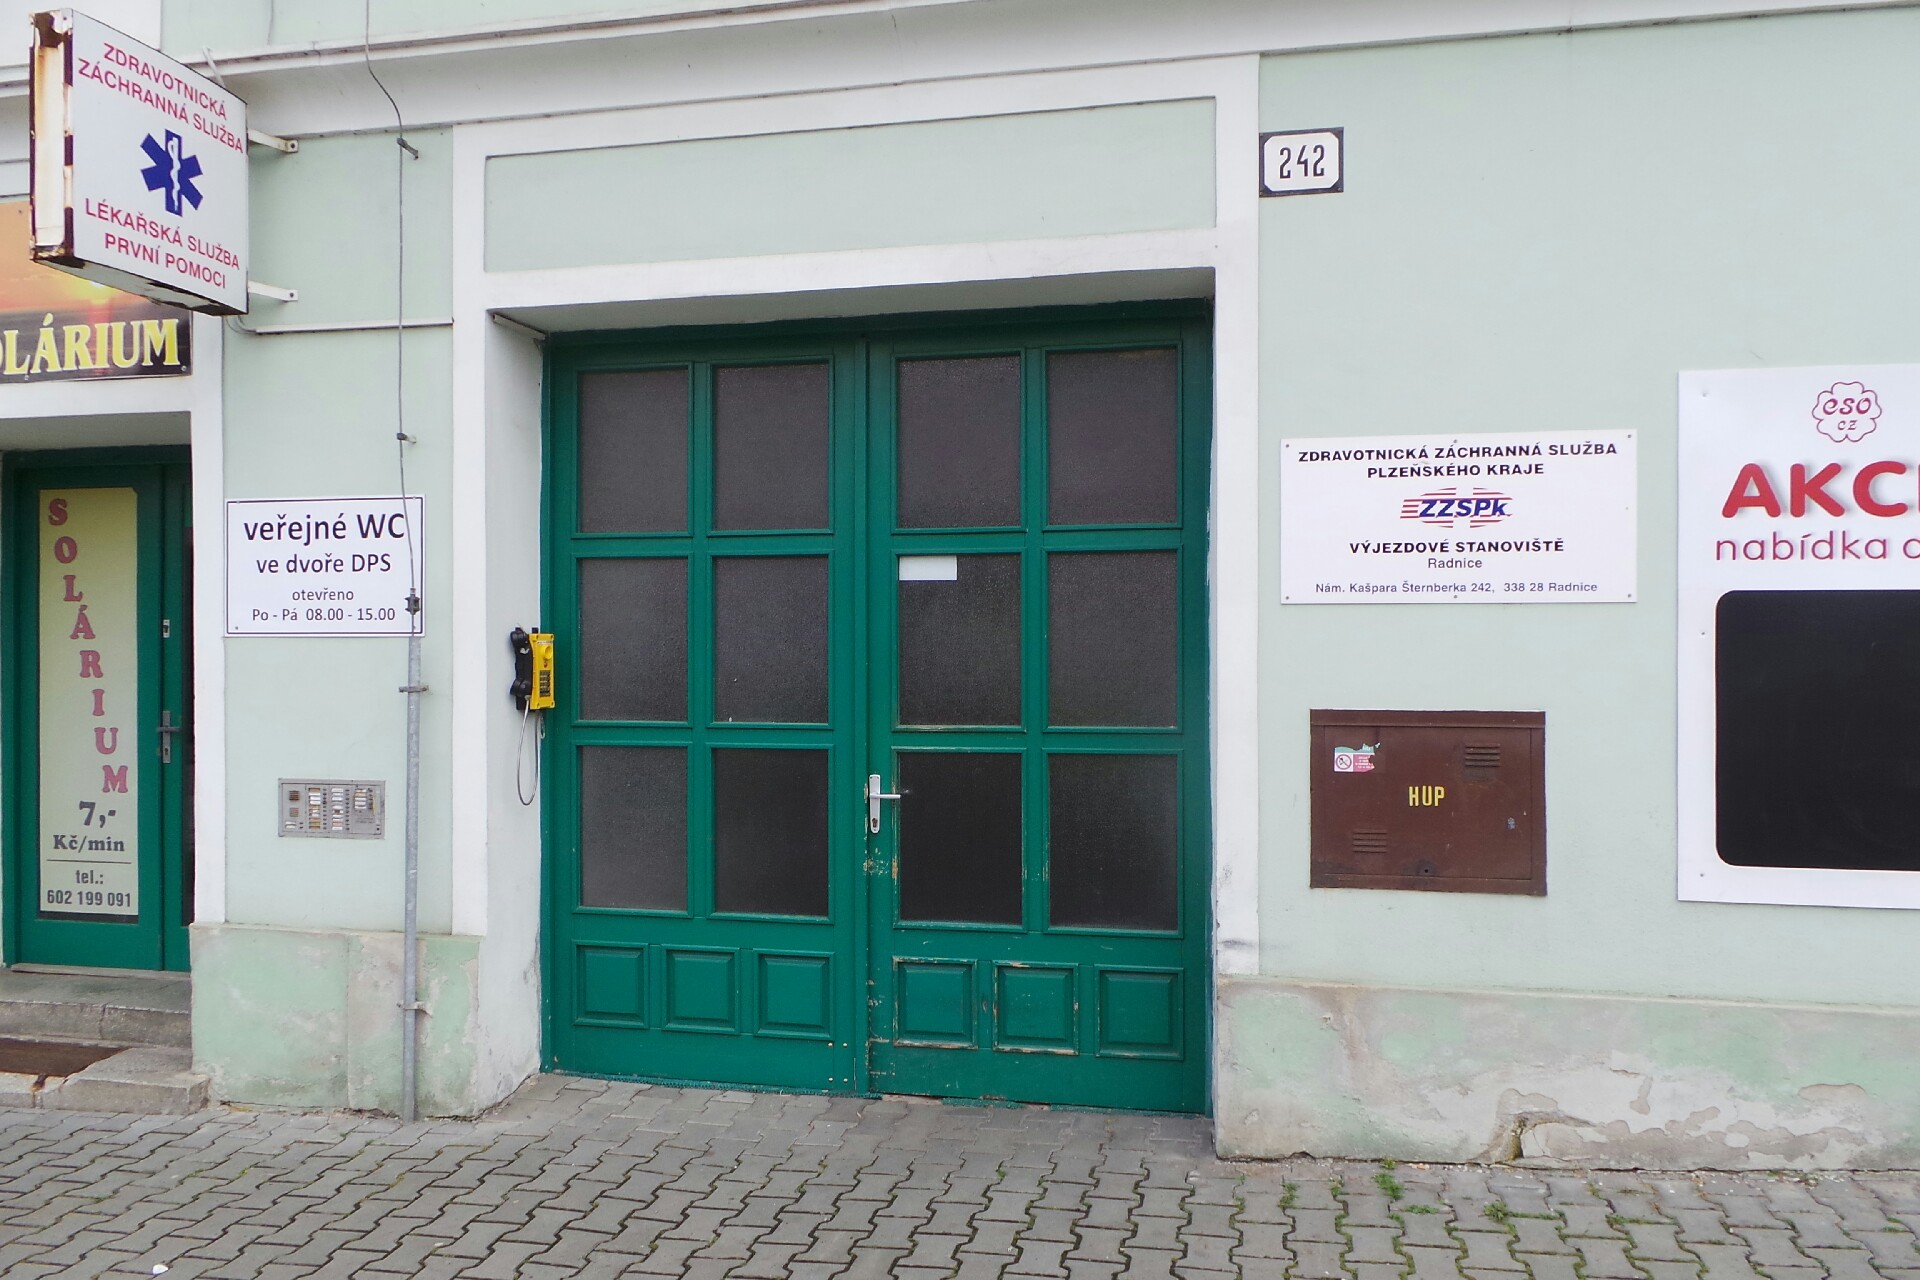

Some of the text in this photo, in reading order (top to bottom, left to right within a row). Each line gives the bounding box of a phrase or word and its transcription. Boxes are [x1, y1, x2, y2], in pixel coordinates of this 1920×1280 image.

[103, 42, 228, 121] ZDRAVOTNICKÁ
[78, 57, 244, 154] ZÁCHRANNÁ SLUŽBA
[1279, 144, 1325, 179] 242
[84, 197, 241, 270] LÉKAŘSKÁ SLUŽBA
[104, 232, 227, 290] PRVNÍ POMOCI
[0, 313, 181, 375] LÁRIUM
[1298, 441, 1618, 463] ZDRAVOTNICKÁ ZÁCHRANNÁ SLUŽBA
[1367, 463, 1545, 479] PLZEŇSKÉHO KRAJE
[1721, 460, 1920, 518] AKC
[243, 512, 405, 547] veřejné WC
[1349, 539, 1565, 554] VÝJEZDOVÉ STANOVIŠTĚ
[1715, 530, 1887, 561] nabídka
[256, 552, 392, 574] ve dvoře DPS
[1428, 557, 1483, 569] Radnice
[291, 587, 354, 601] otevřeno
[1315, 579, 1598, 595] Nám. Kašpara Šternberka 242, 338 28 Radnice
[252, 609, 269, 621] Po
[282, 607, 298, 621] Pá
[305, 608, 344, 621] 08.00
[357, 607, 396, 621] 15.00
[48, 498, 128, 794] SOLÁRIUM
[1408, 785, 1445, 807] HUP
[53, 834, 125, 853] Kč/min
[75, 870, 103, 884] tel.:
[47, 889, 131, 907] 602 199 091
